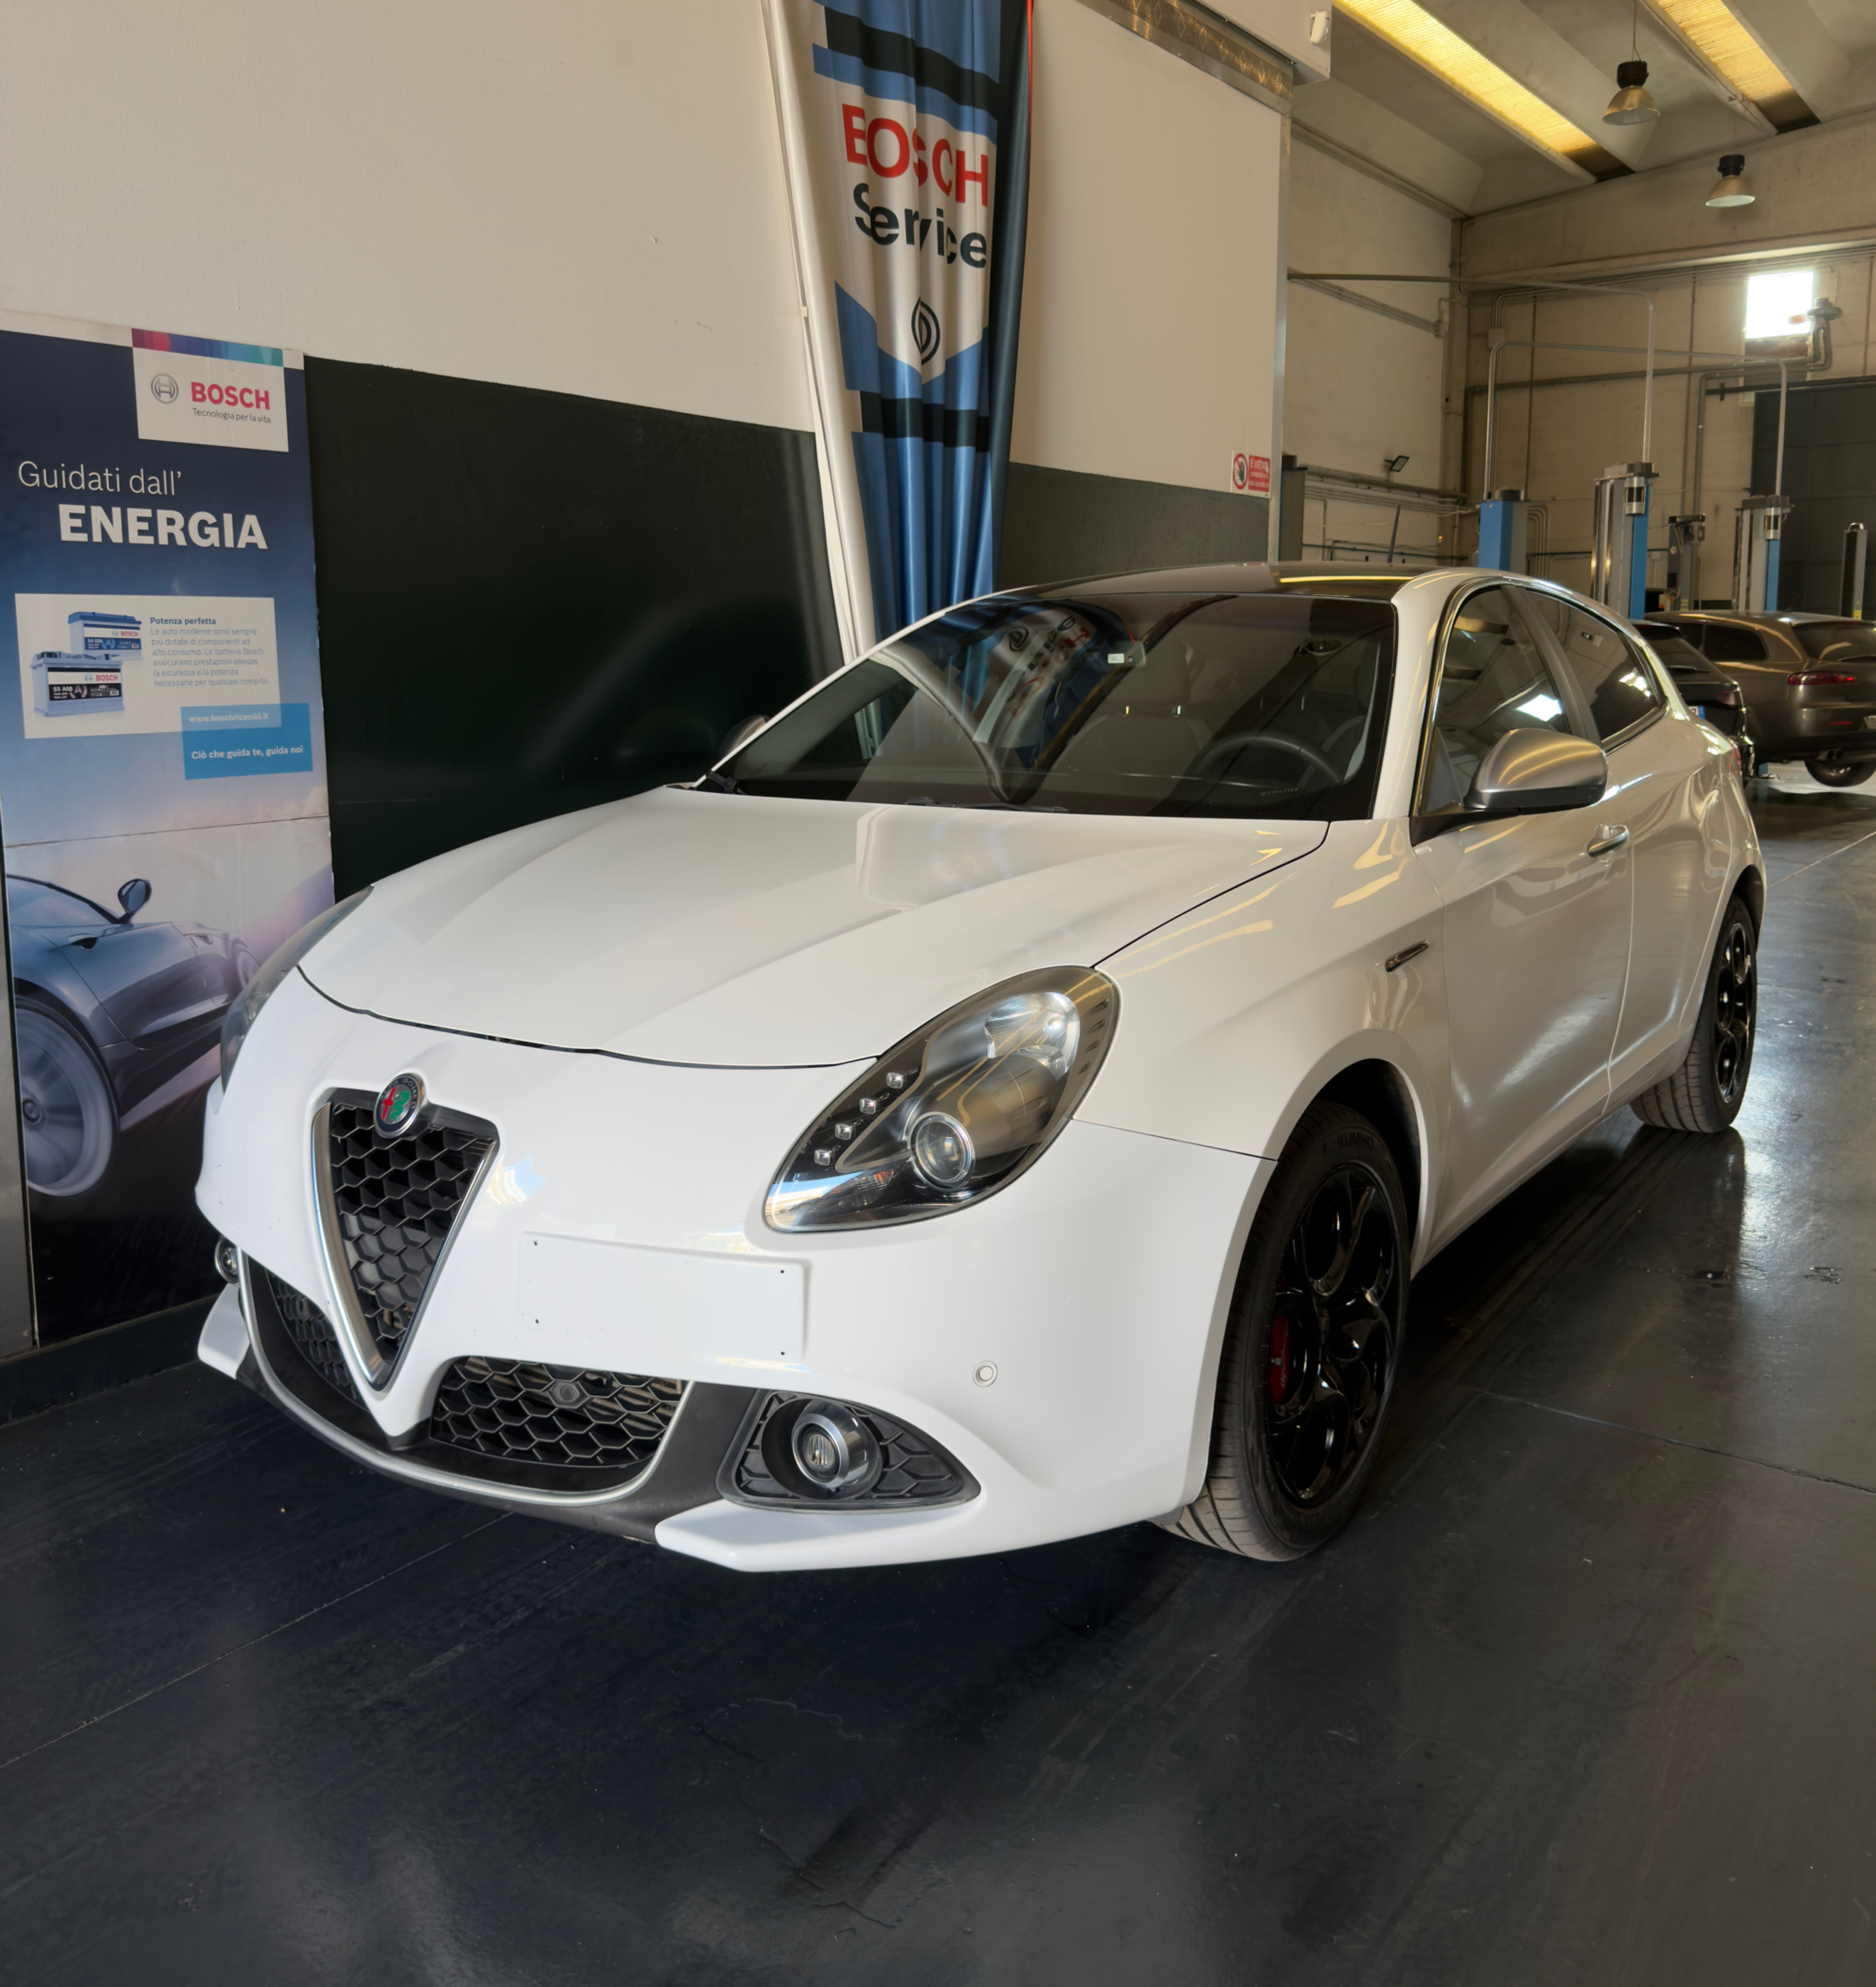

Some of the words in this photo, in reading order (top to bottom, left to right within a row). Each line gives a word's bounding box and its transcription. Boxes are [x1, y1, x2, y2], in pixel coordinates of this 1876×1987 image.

[191, 381, 270, 410] BOSCH
[192, 407, 234, 421] Tecnologia
[250, 414, 256, 422] la
[258, 415, 271, 423] vita
[19, 461, 120, 492] Guidati
[59, 504, 268, 550] ENERGIA
[185, 617, 216, 626] perfetta
[152, 638, 163, 647] più
[209, 678, 238, 687] qualsiasi
[189, 712, 269, 722] www.boschricambi.it
[192, 751, 207, 759] Ciò
[209, 750, 225, 758] che
[227, 749, 250, 759] guida
[253, 748, 264, 757] te,
[266, 746, 288, 757] guida
[291, 745, 303, 754] noi
[1337, 1132, 1374, 1151] KUMHO
